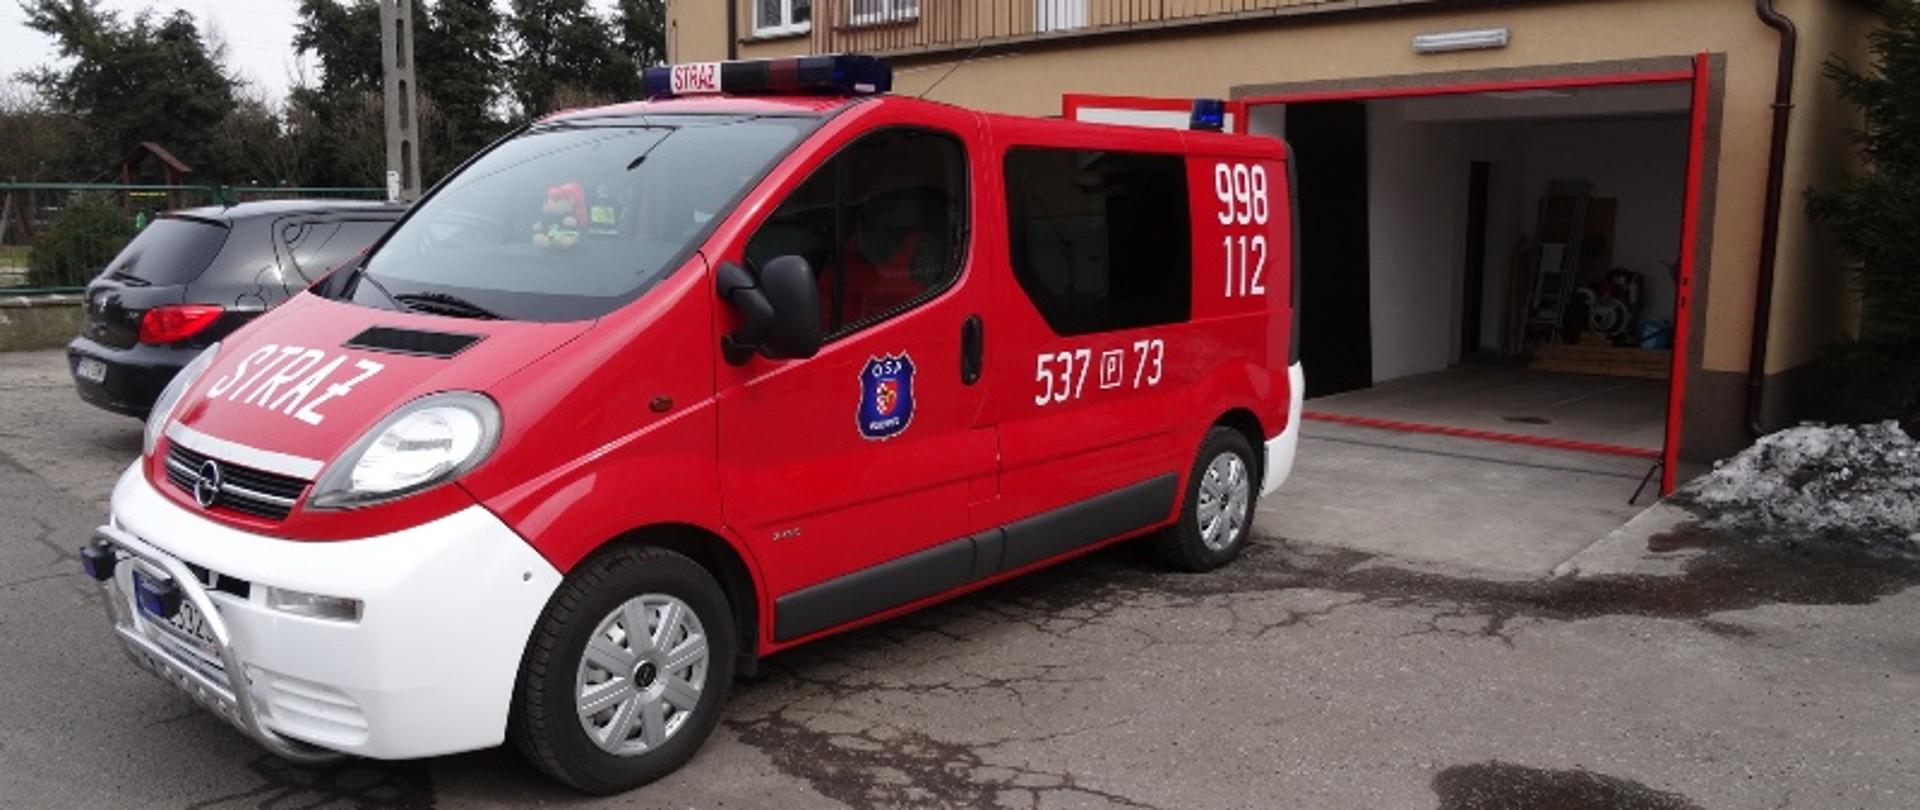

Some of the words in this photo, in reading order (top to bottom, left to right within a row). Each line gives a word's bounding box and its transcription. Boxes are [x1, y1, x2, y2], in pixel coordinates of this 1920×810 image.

[674, 65, 715, 91] STRAŻ
[1215, 163, 1268, 225] 998
[1223, 235, 1267, 297] 112
[206, 344, 385, 426] STRAŻ
[1035, 348, 1092, 406] 537
[1133, 338, 1164, 389] 73
